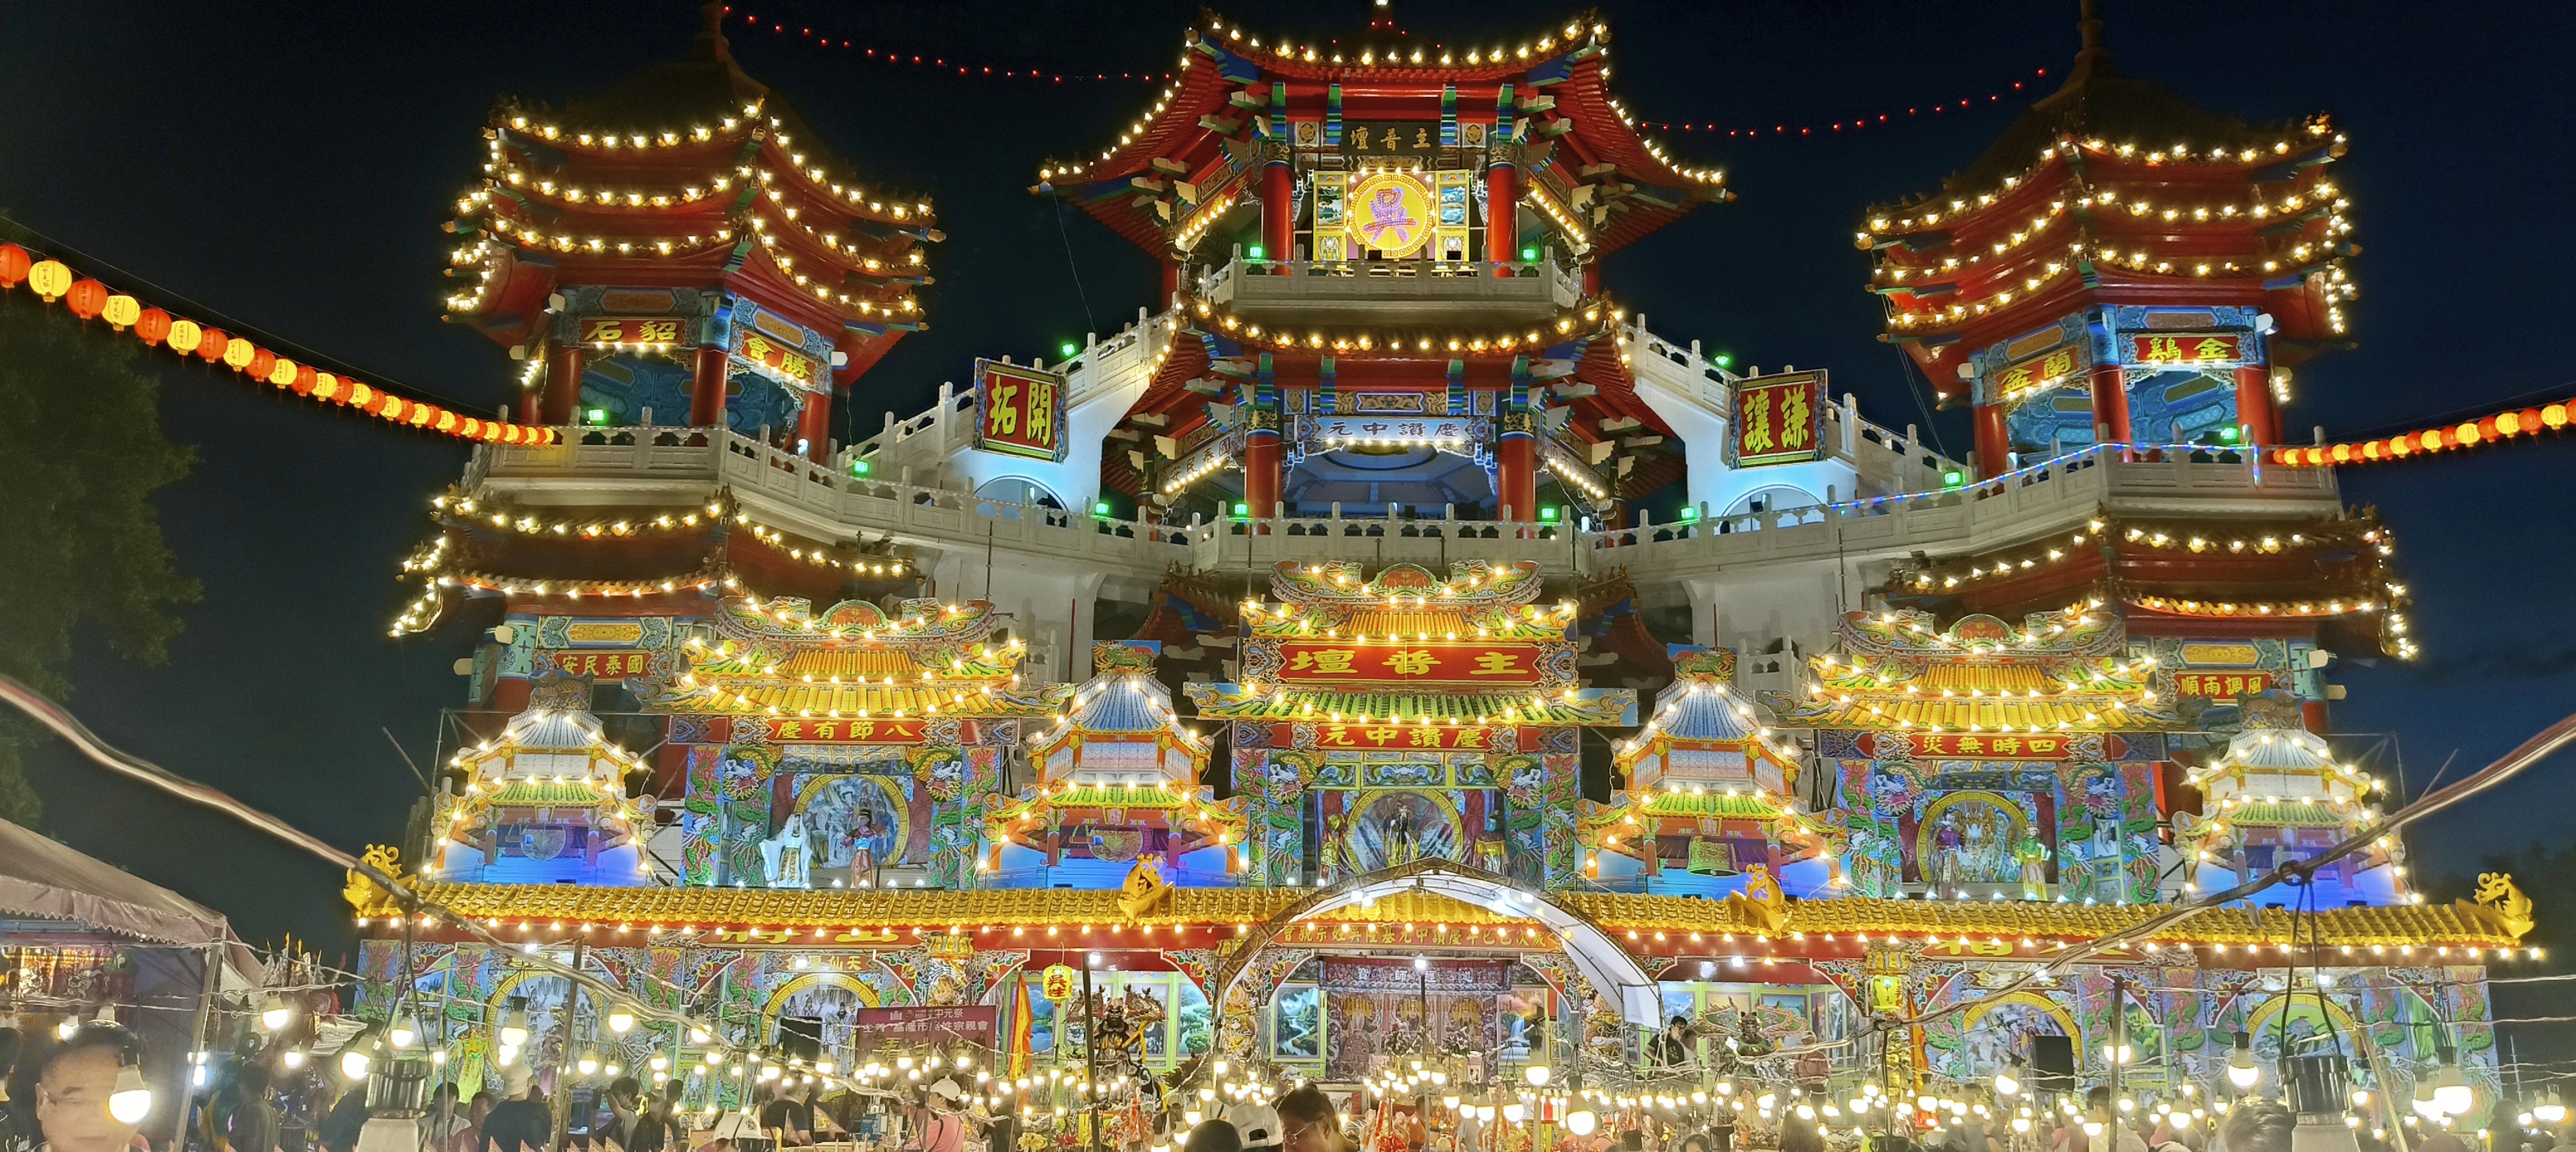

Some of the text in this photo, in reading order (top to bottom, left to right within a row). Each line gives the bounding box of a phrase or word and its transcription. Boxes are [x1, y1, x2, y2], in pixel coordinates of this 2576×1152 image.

[1350, 126, 1431, 152] 主普壇
[584, 321, 677, 341] 貂石
[744, 336, 812, 378] 勝會
[2002, 352, 2072, 394] 蘭盆
[989, 375, 1052, 446] 開拓
[1743, 384, 1809, 454] 謙讓
[563, 654, 644, 676] 國泰民安
[1290, 649, 1528, 675] 主普壇
[2181, 675, 2262, 696] 風調雨順
[776, 720, 914, 740] 八節有慶
[1322, 726, 1485, 748] 慶讚中元
[1922, 736, 2056, 755] 四時無災
